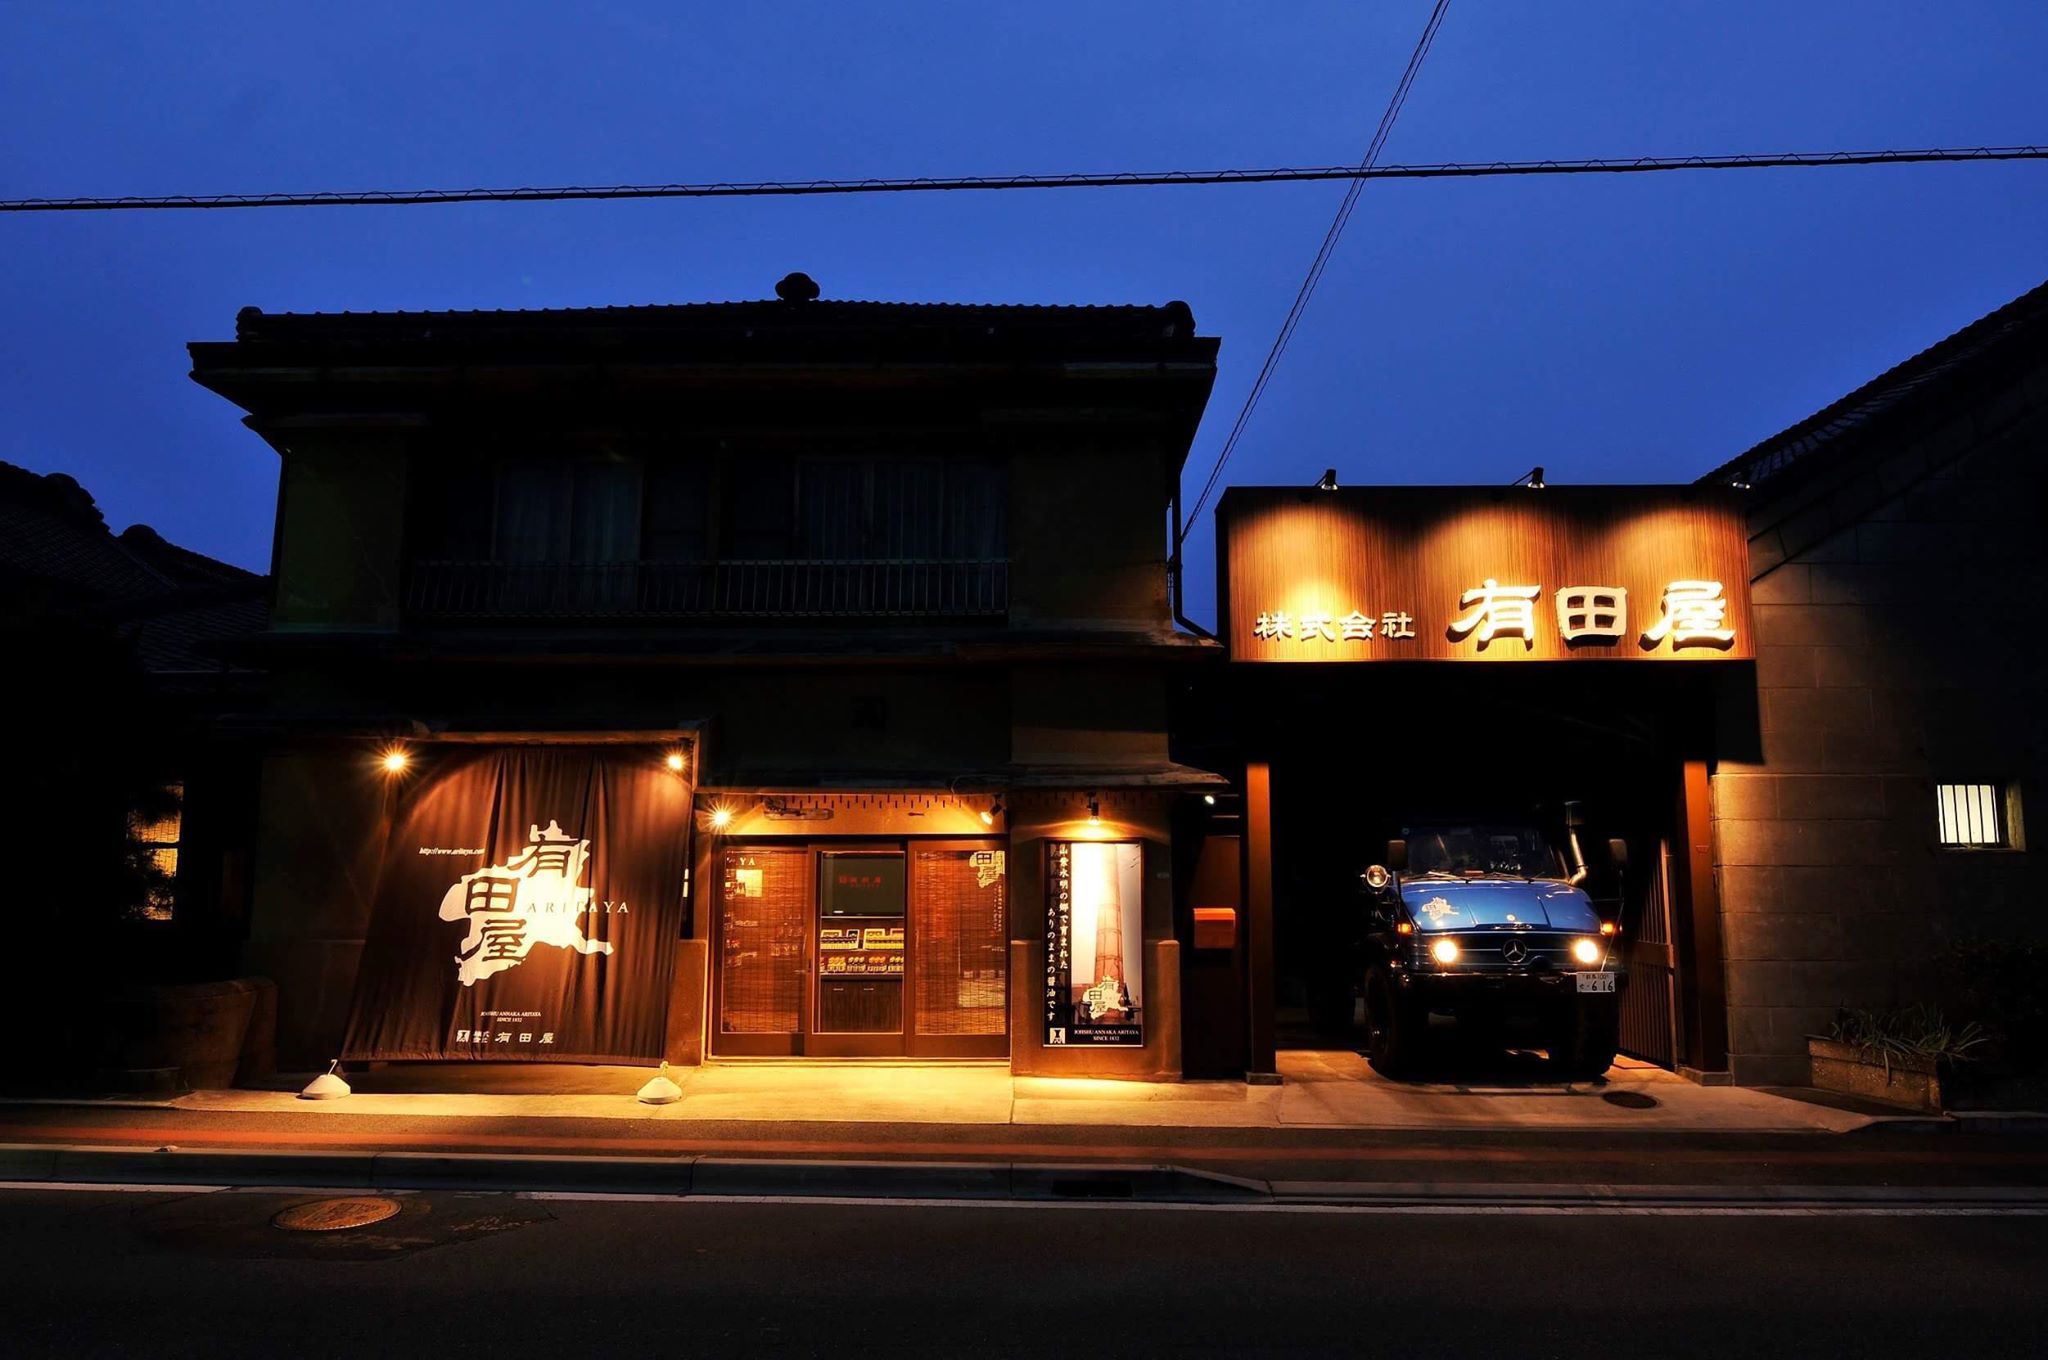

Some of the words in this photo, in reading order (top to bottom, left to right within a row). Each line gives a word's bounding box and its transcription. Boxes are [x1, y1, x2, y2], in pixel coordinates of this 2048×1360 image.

[1254, 611, 1416, 642] 株式会社
[1447, 579, 1736, 650] 有田屋
[461, 833, 578, 962] 有田屋
[527, 901, 629, 914] ARITAYA
[494, 1032, 554, 1044] 有田屋
